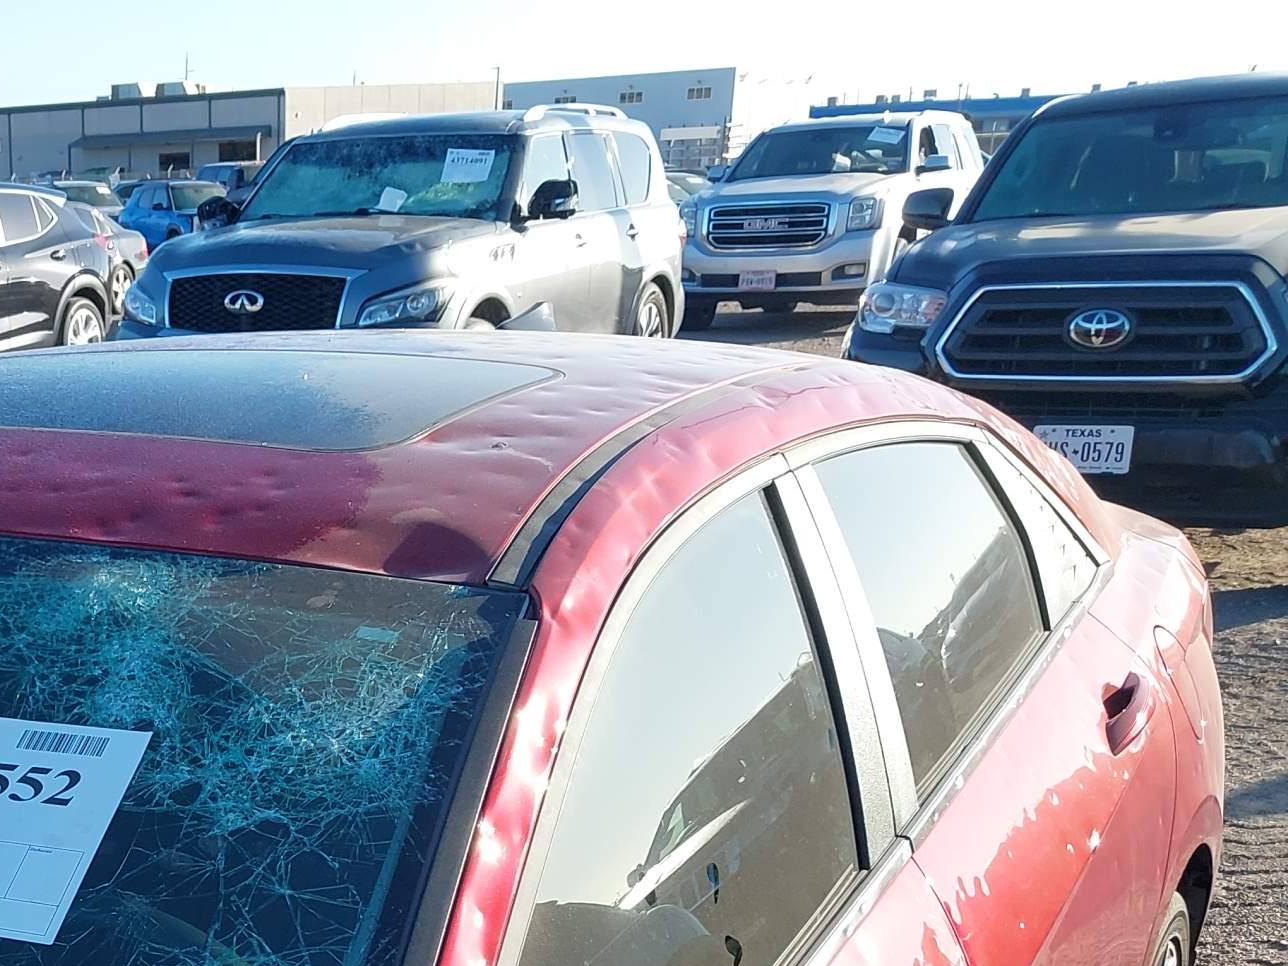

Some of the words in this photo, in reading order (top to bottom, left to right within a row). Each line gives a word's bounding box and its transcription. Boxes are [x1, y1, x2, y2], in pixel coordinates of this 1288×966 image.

[743, 218, 789, 230] GMC
[1065, 428, 1102, 438] TEXAS
[1080, 441, 1124, 463] 0579
